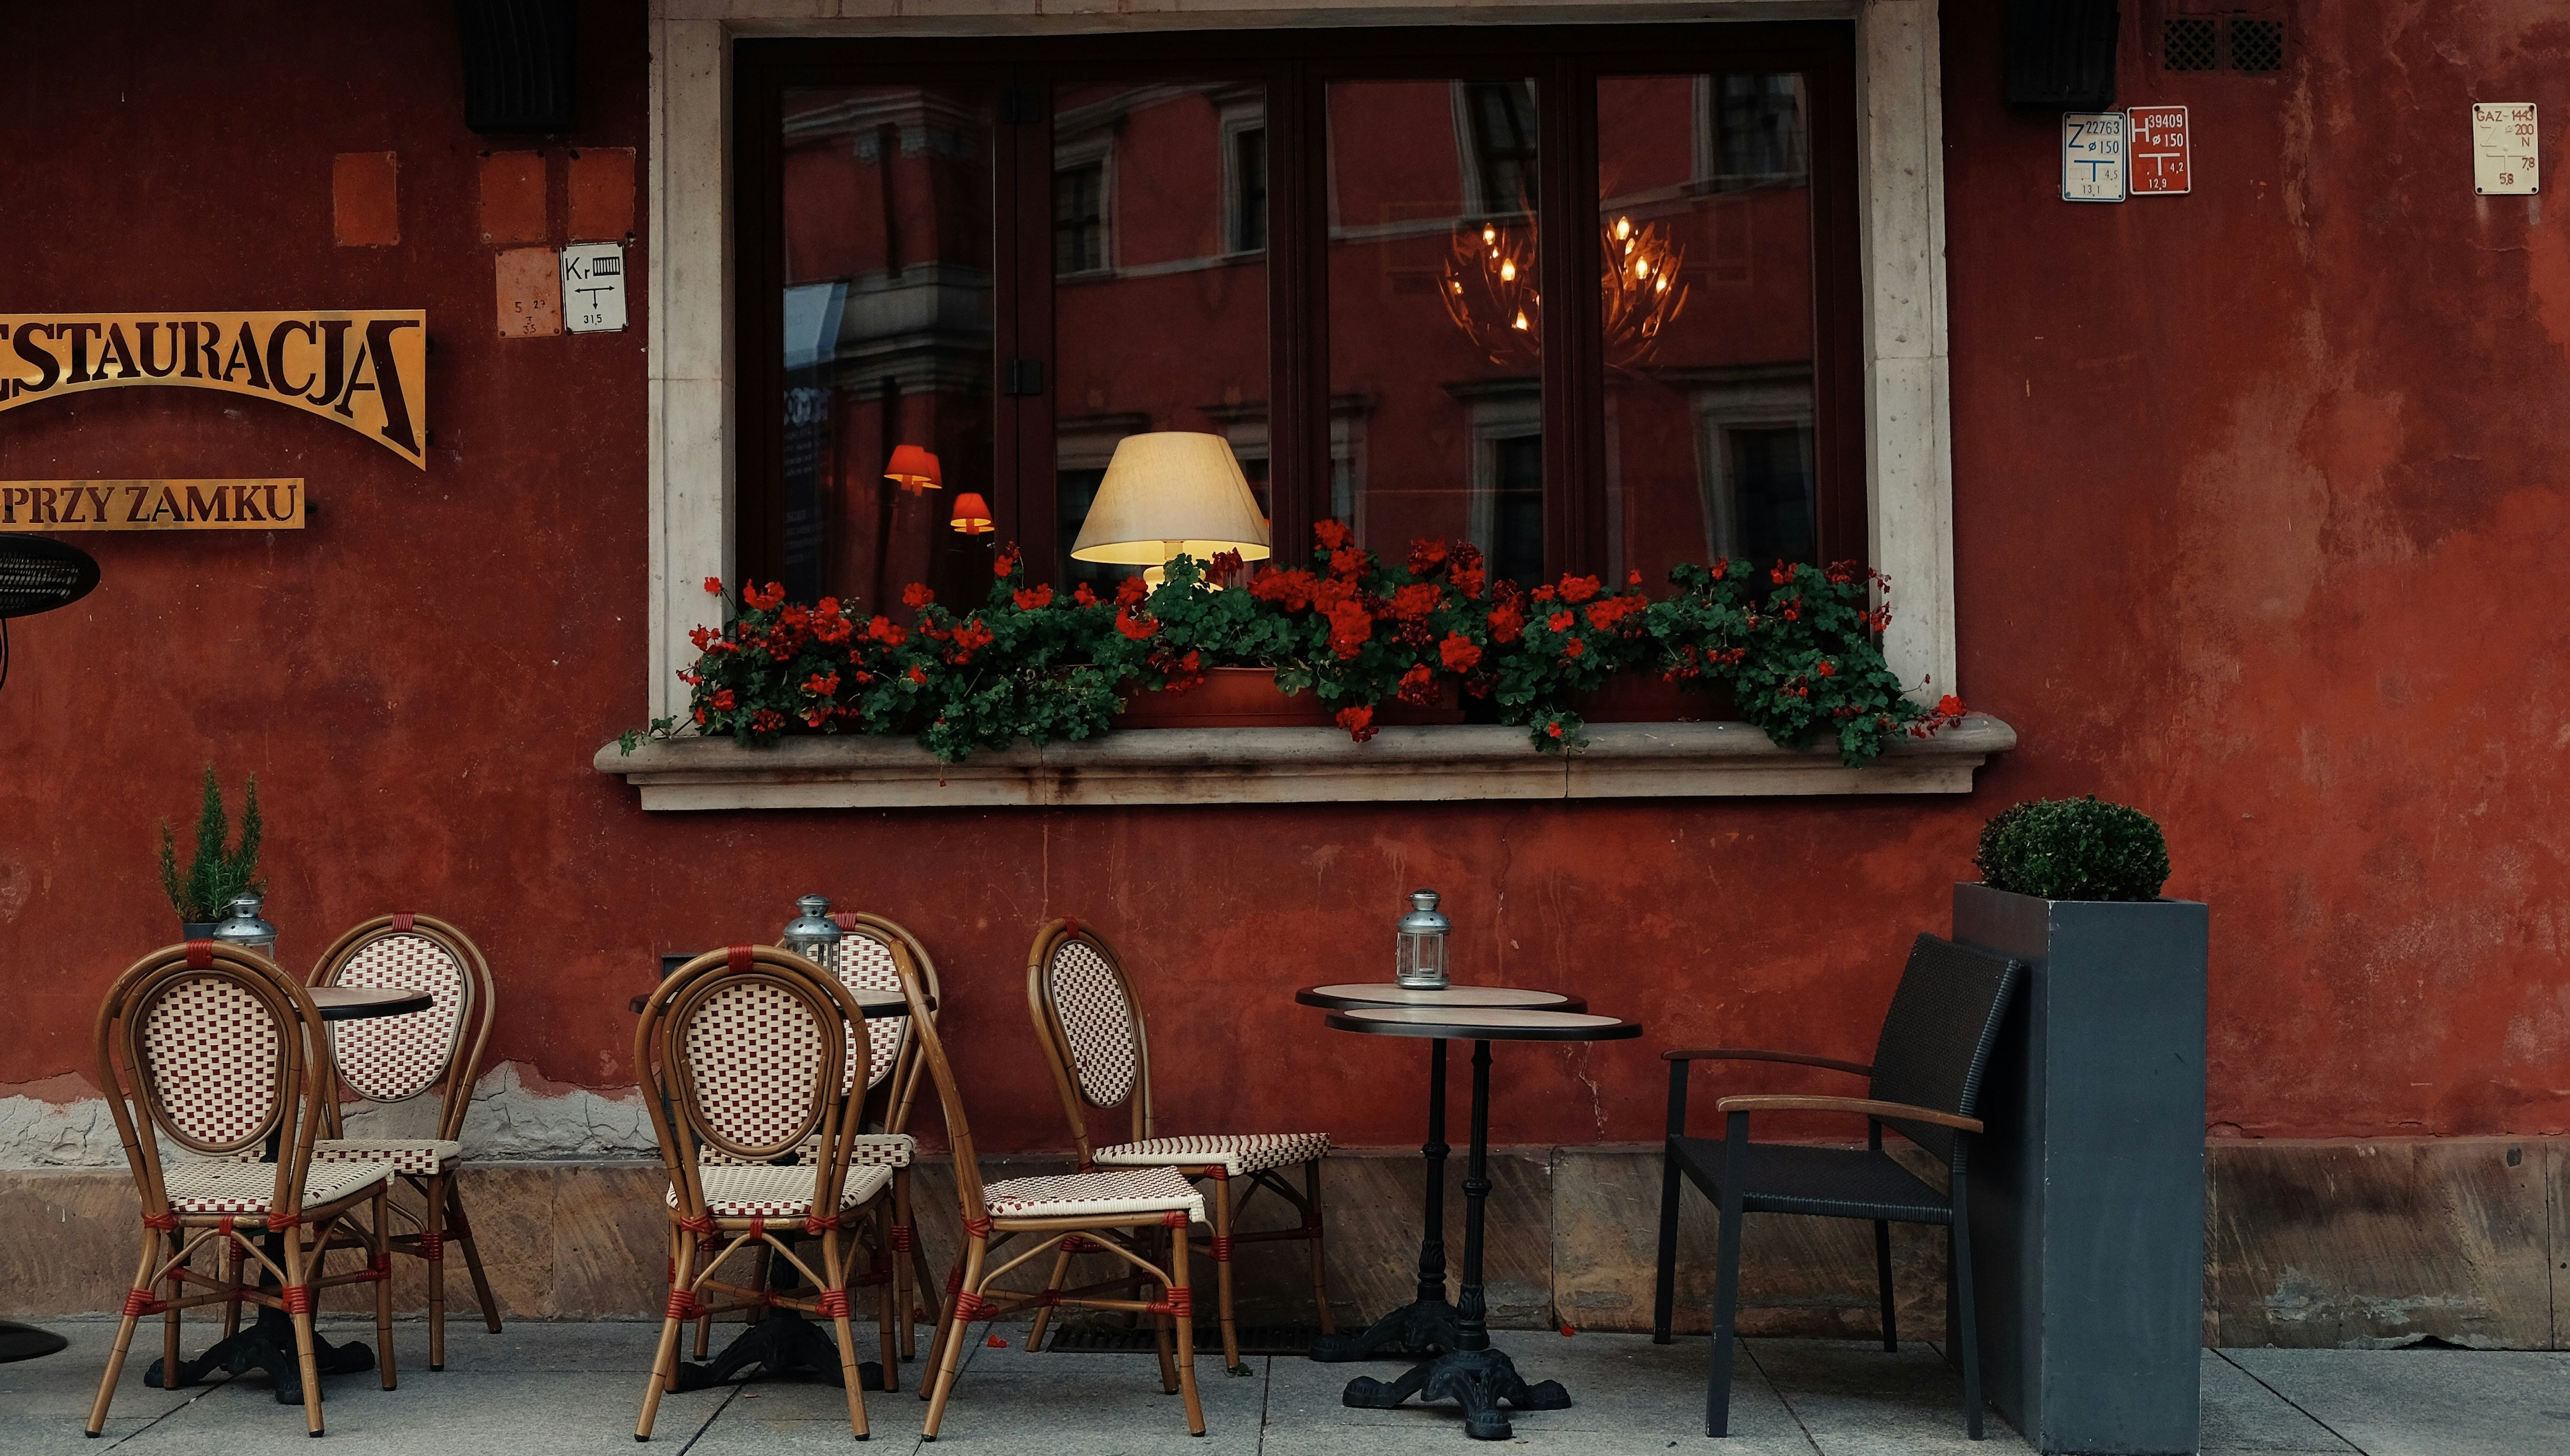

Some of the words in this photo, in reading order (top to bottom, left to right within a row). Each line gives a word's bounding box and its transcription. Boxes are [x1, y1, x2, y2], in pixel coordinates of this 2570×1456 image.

[2068, 124, 2085, 149] Z
[2086, 121, 2120, 135] 22763
[2131, 117, 2150, 143] H
[2149, 113, 2183, 128] 39409
[2515, 123, 2534, 135] 200
[2100, 140, 2120, 154] 150
[2164, 133, 2184, 147] 150
[2522, 136, 2530, 147] N
[565, 256, 591, 281] Kr
[515, 301, 522, 313] 5
[1, 486, 116, 524] PRZY
[124, 483, 297, 523] ZAMKU
